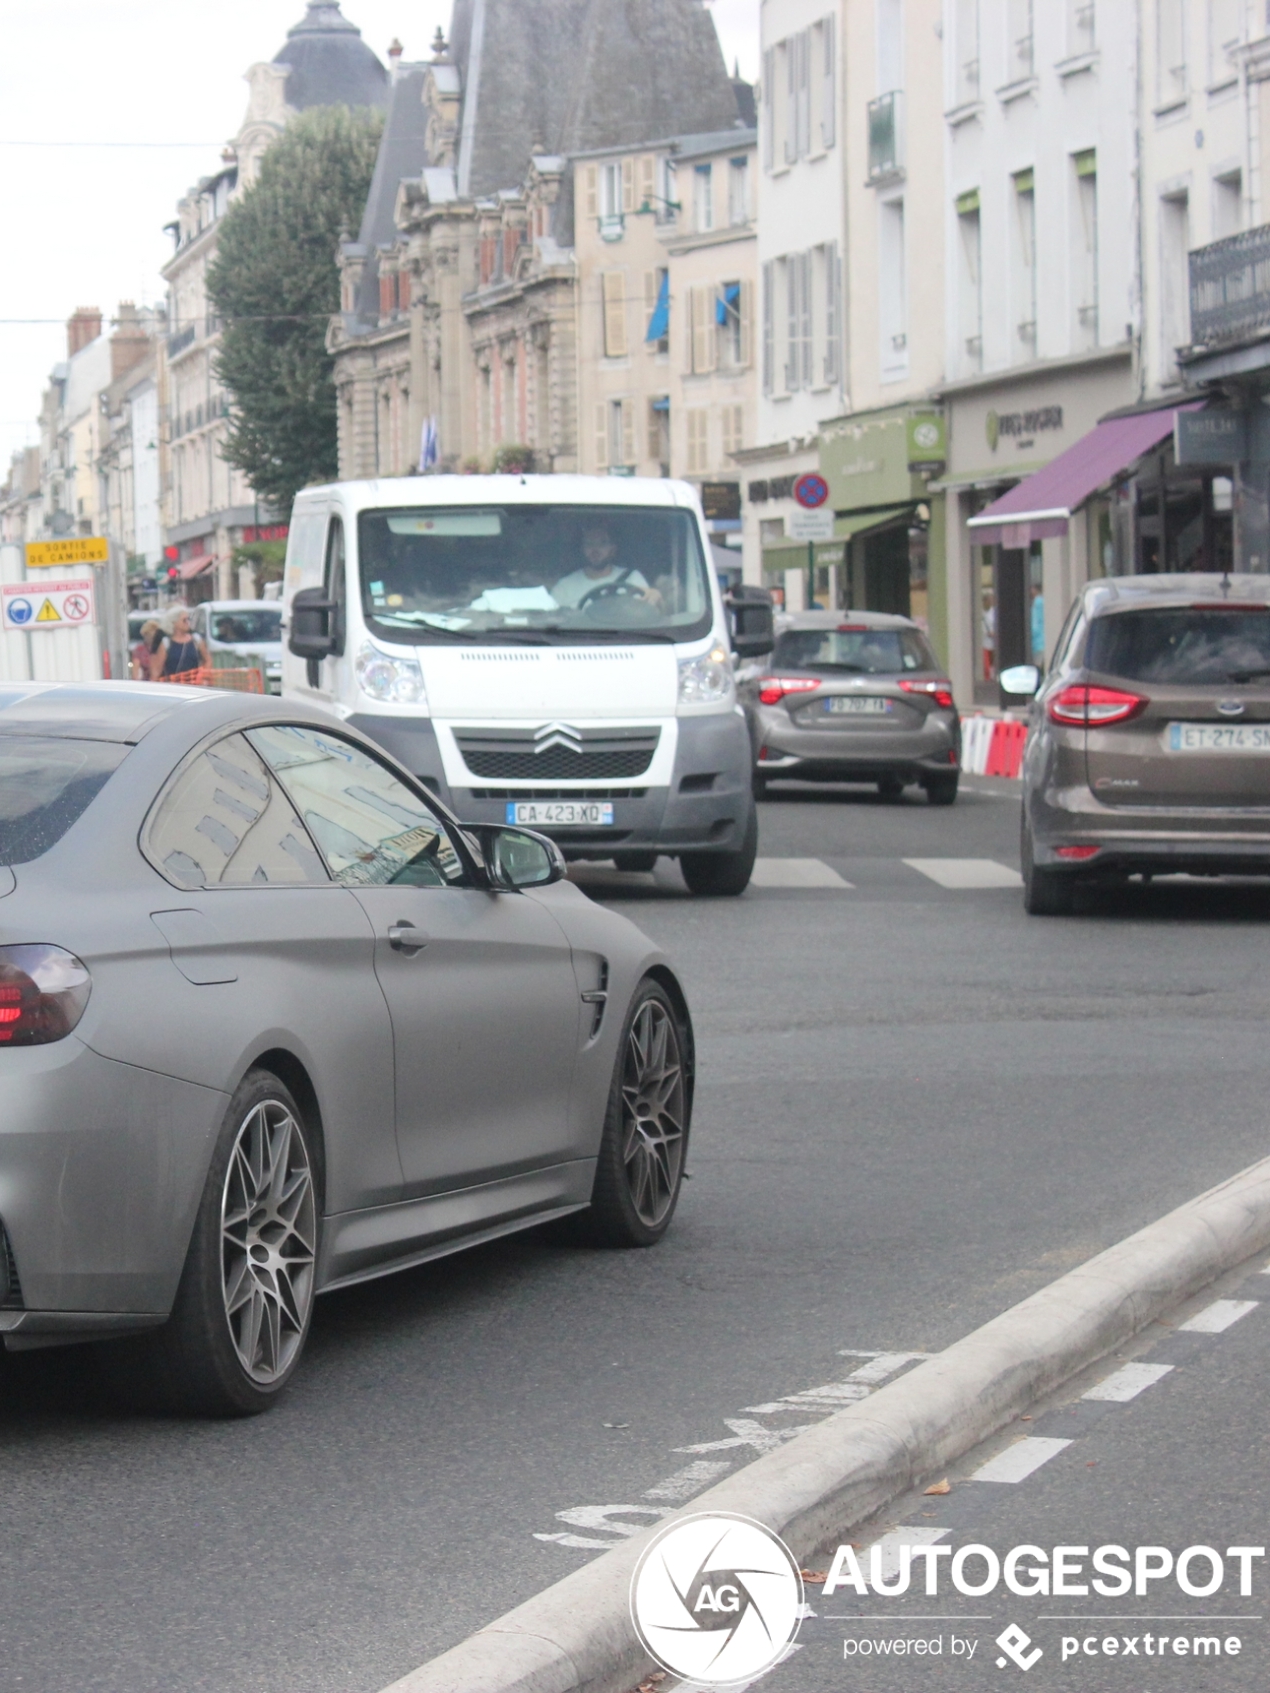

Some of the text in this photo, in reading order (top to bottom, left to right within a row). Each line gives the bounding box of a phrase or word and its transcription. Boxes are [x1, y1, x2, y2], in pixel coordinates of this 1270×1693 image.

[45, 541, 88, 552] SORTIE
[29, 550, 104, 563] DE CAMIONS
